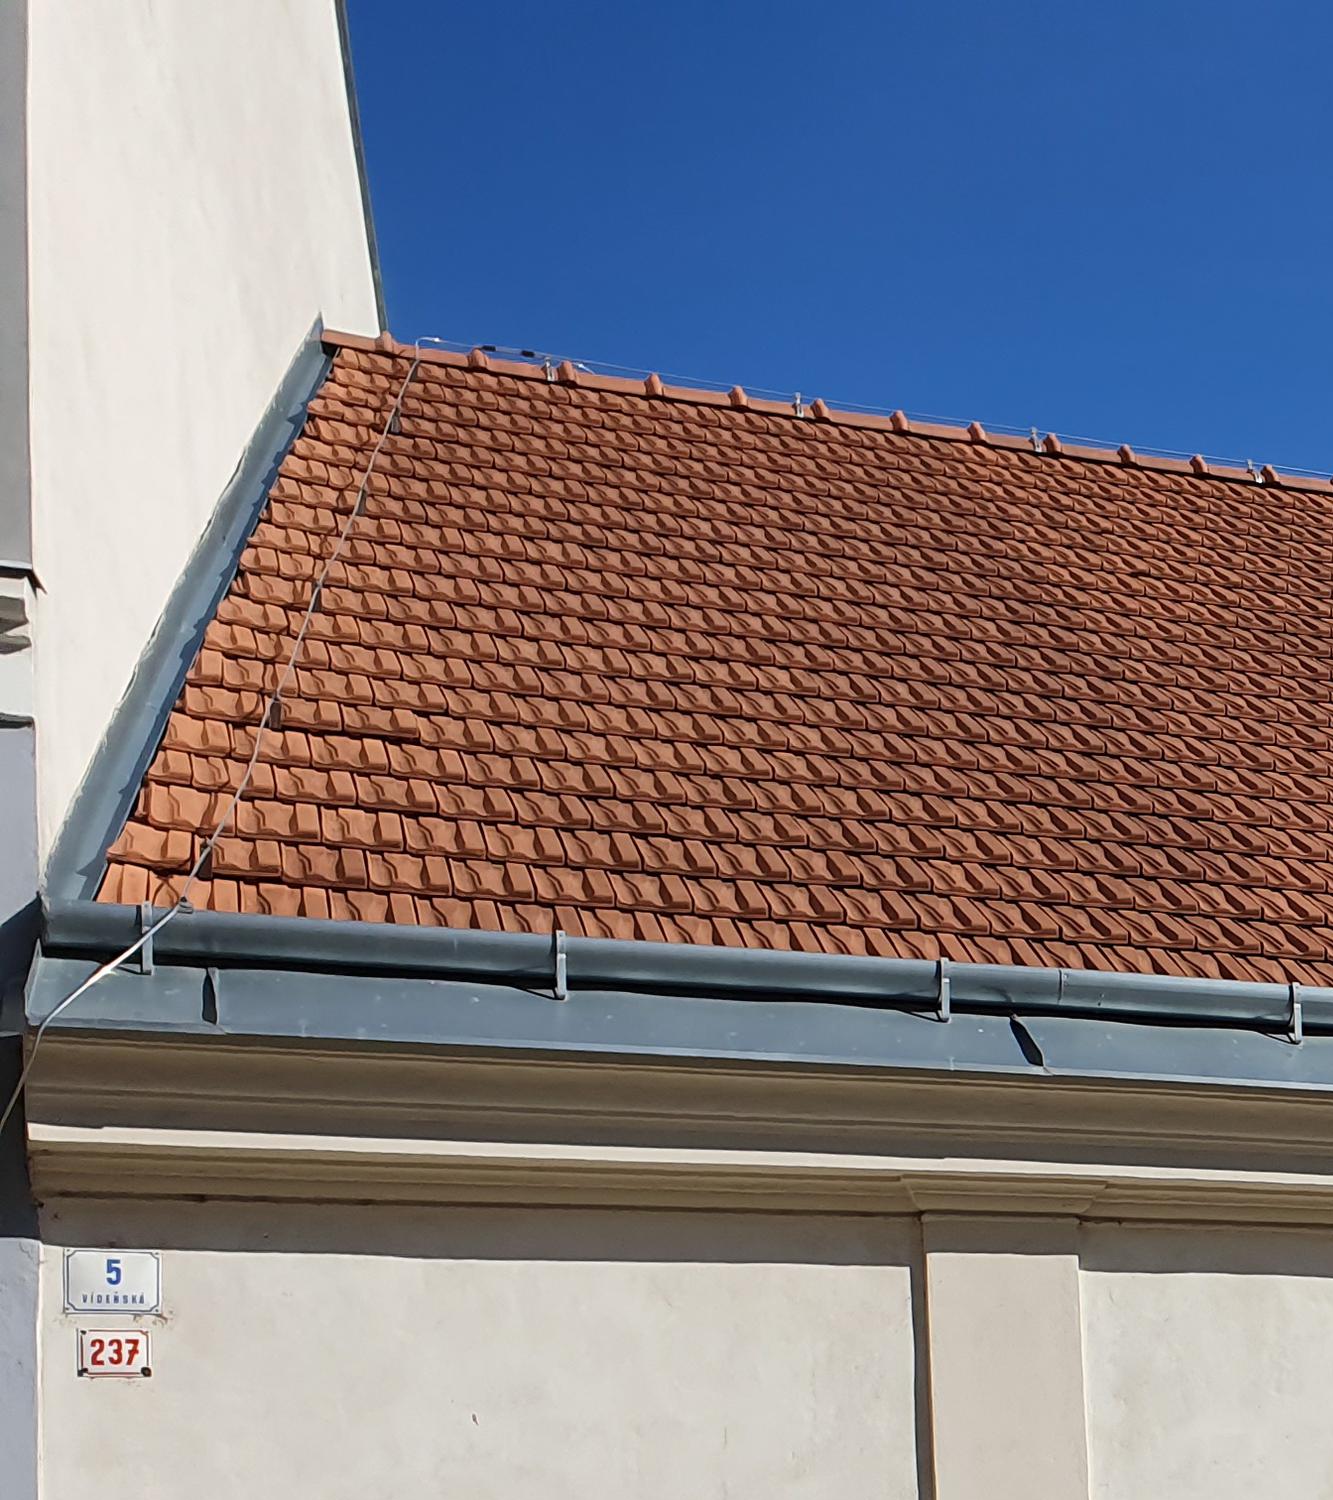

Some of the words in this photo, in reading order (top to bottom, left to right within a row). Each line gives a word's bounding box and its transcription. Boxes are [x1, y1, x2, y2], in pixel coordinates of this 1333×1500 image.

[106, 1259, 122, 1285] 5
[82, 1291, 145, 1304] VÍDEŇSKÁ
[90, 1338, 140, 1366] 237
